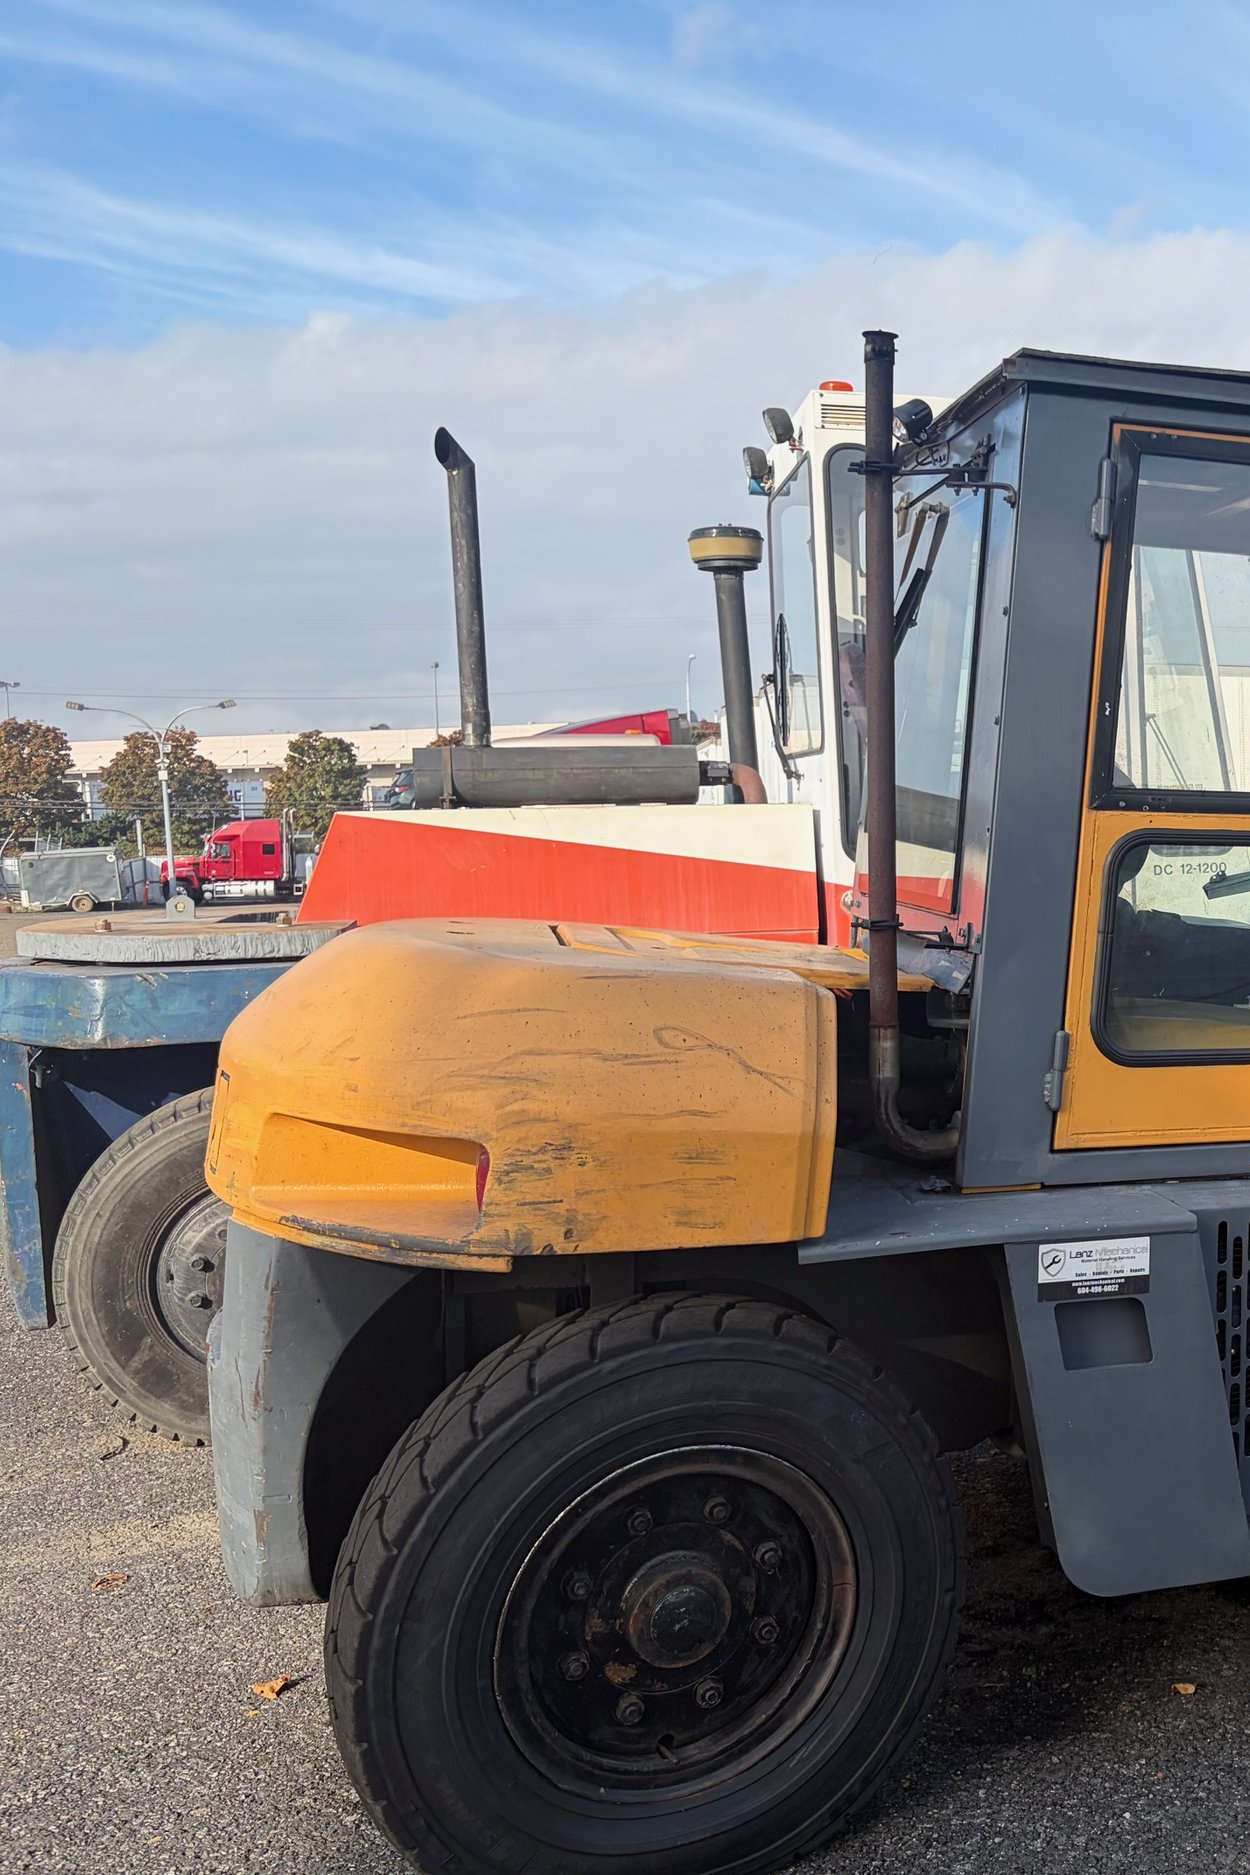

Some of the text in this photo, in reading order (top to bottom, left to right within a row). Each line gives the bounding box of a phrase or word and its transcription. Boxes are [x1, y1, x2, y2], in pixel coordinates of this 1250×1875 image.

[1153, 861, 1227, 876] DC 12-1200
[1069, 1250, 1093, 1259] Lanz
